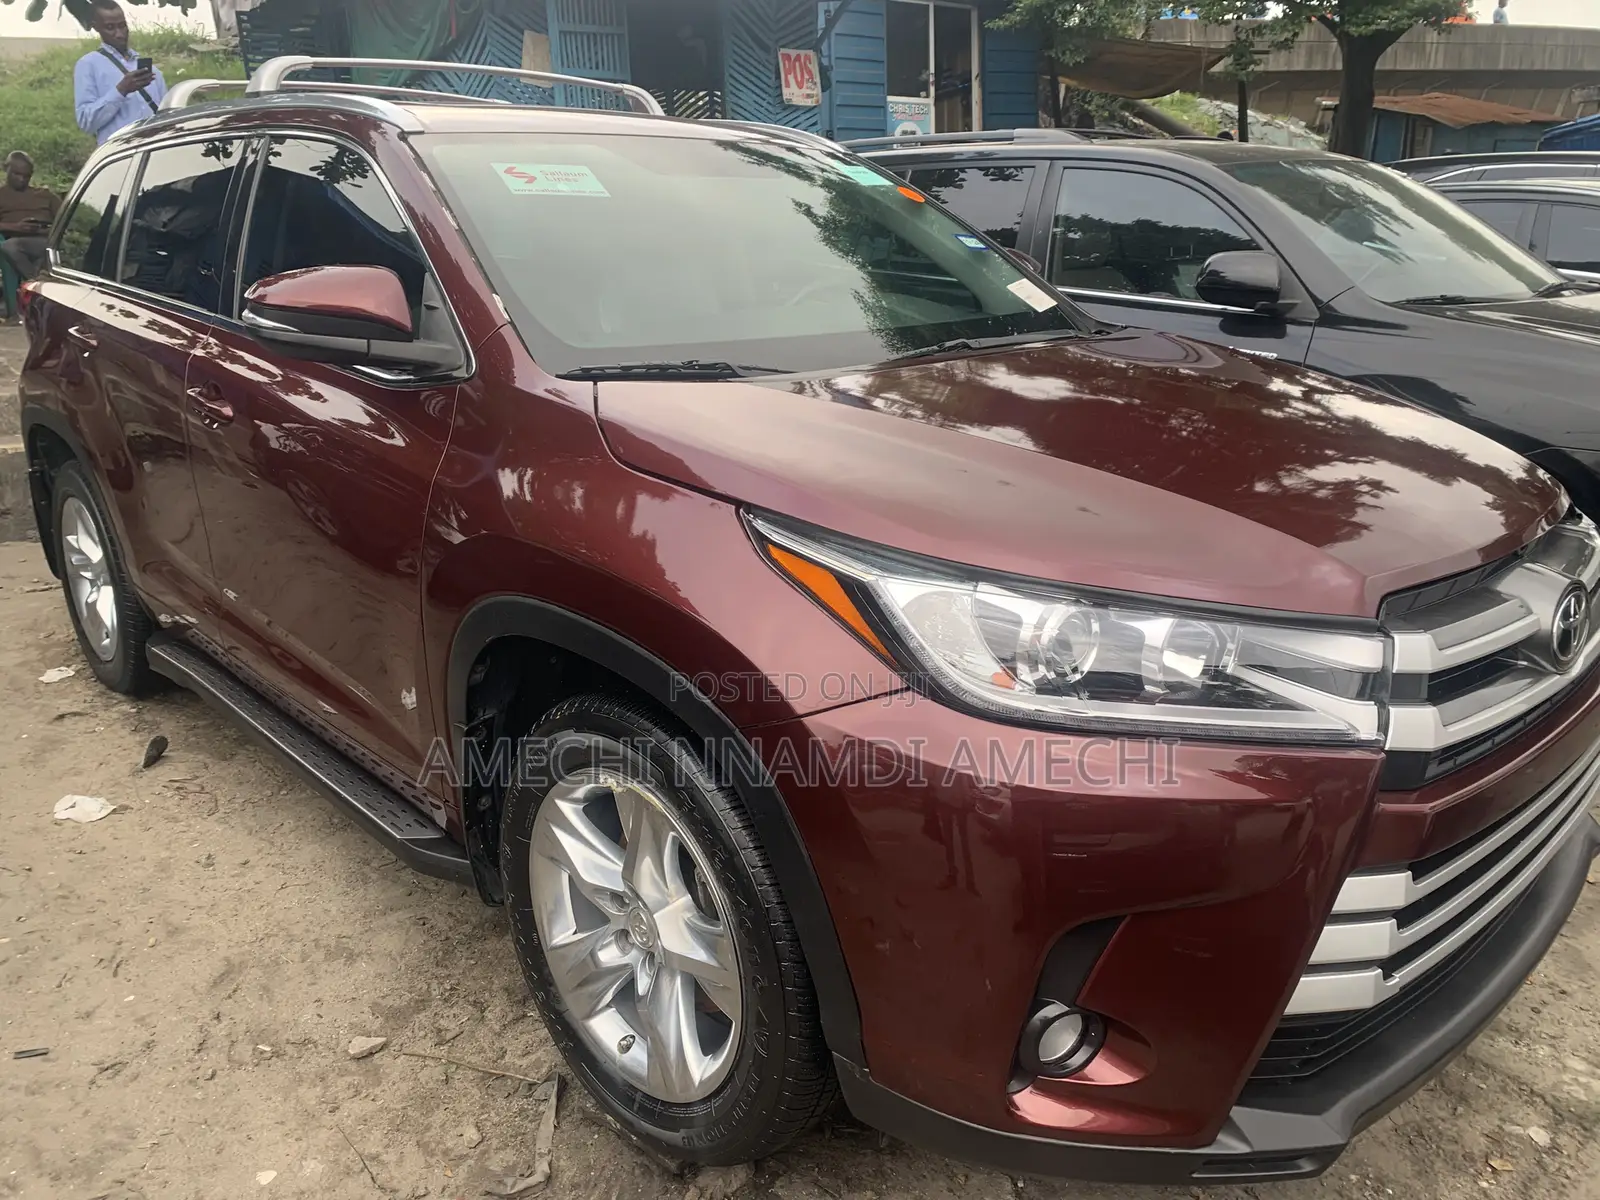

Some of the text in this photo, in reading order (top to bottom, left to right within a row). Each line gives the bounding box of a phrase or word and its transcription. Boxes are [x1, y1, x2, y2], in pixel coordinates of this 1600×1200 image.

[780, 53, 814, 89] POS
[888, 103, 928, 114] CHRIS TECH
[544, 175, 579, 183] Lines
